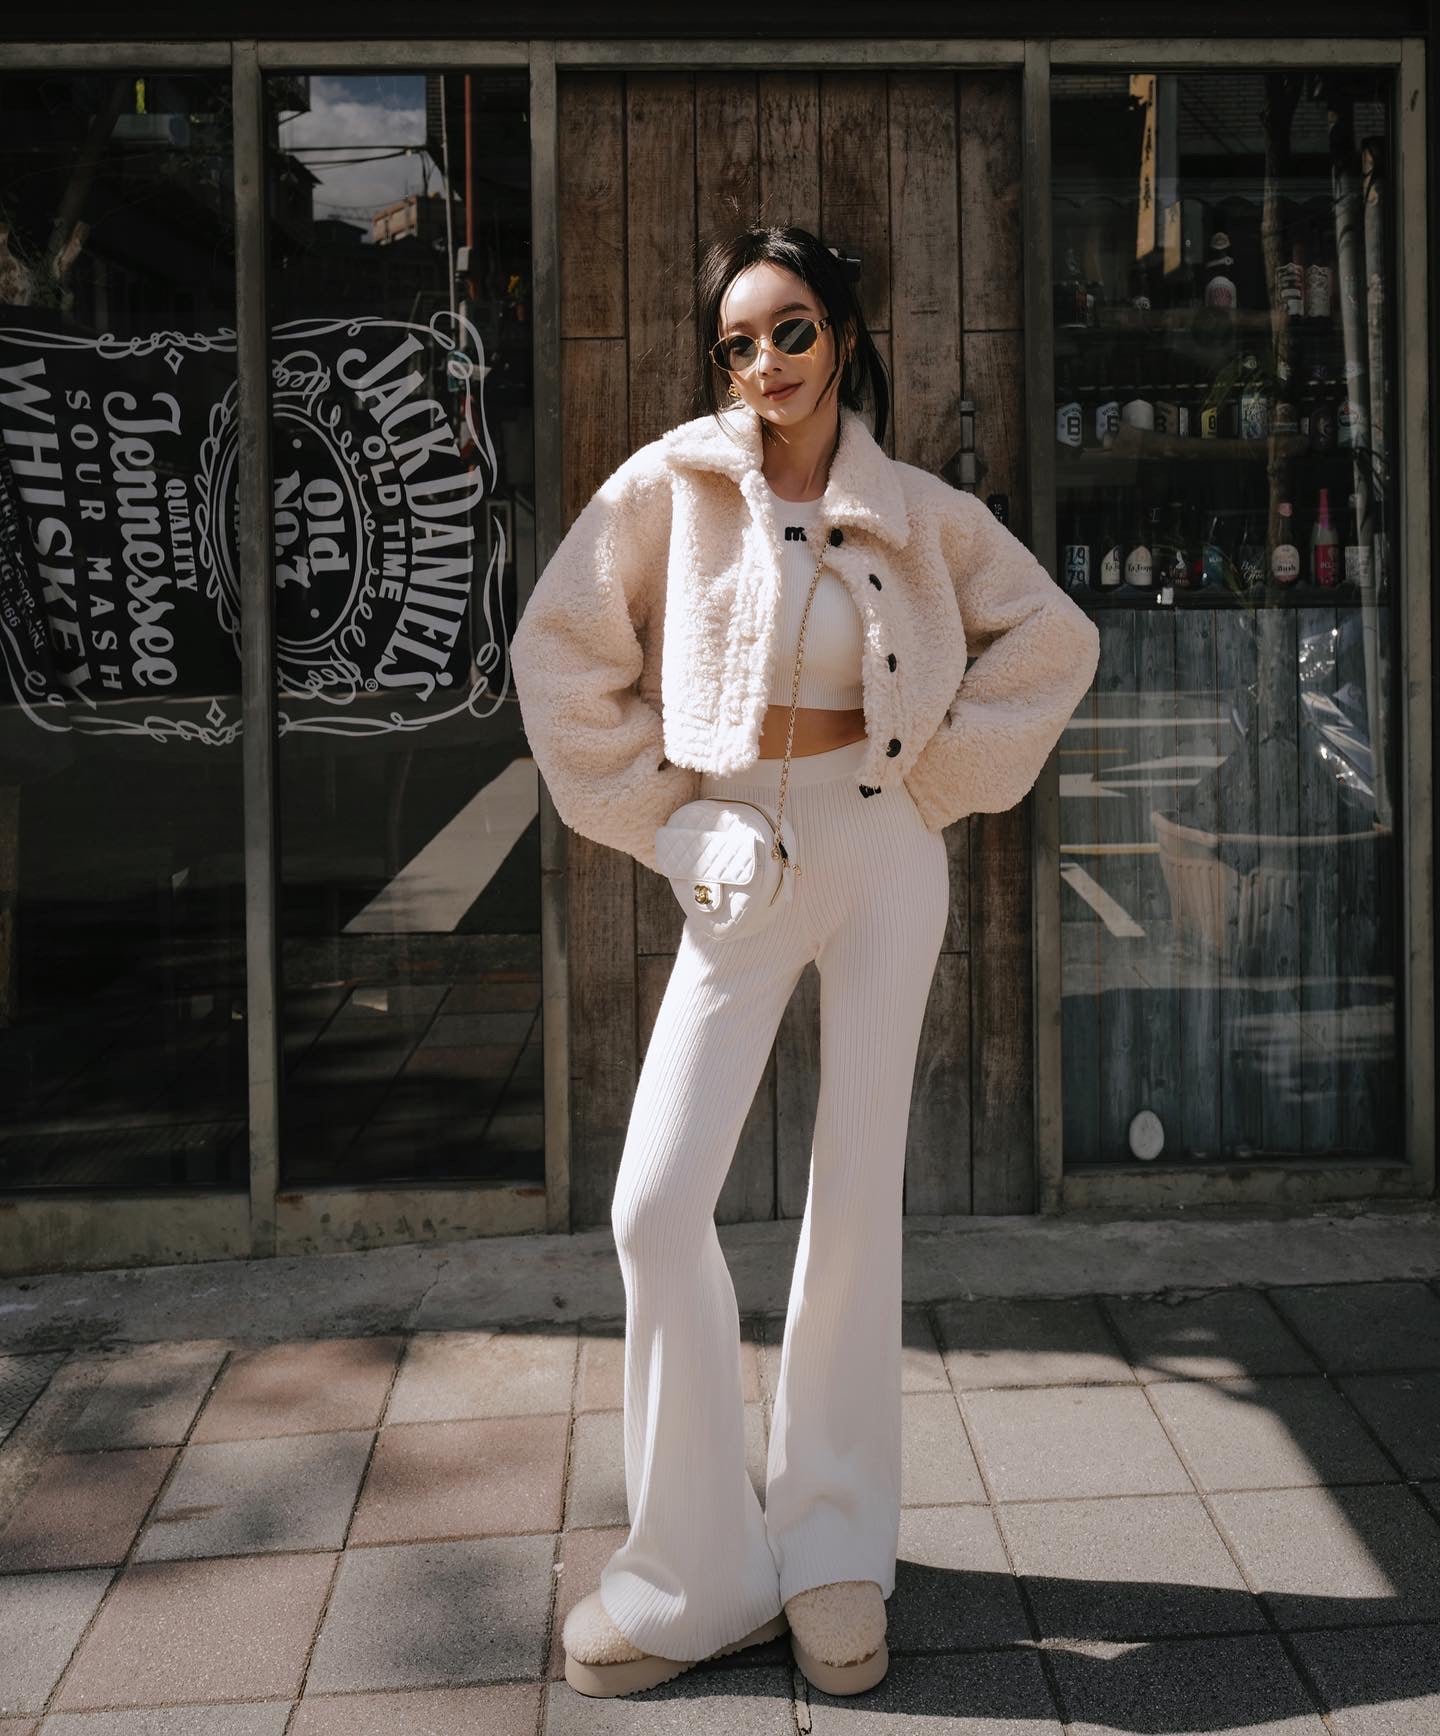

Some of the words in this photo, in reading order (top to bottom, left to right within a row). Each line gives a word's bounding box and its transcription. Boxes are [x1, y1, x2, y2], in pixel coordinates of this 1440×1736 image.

[337, 333, 460, 481] JACK
[363, 435, 402, 508] OLD
[0, 357, 98, 711] WHISKEY
[65, 390, 106, 521] SOUR
[86, 556, 123, 690] MASH
[102, 391, 182, 687] Tennessee
[164, 478, 198, 592] QUALITY
[302, 477, 351, 576] Old
[373, 468, 484, 702] DANIEL'S
[378, 522, 408, 603] TIME
